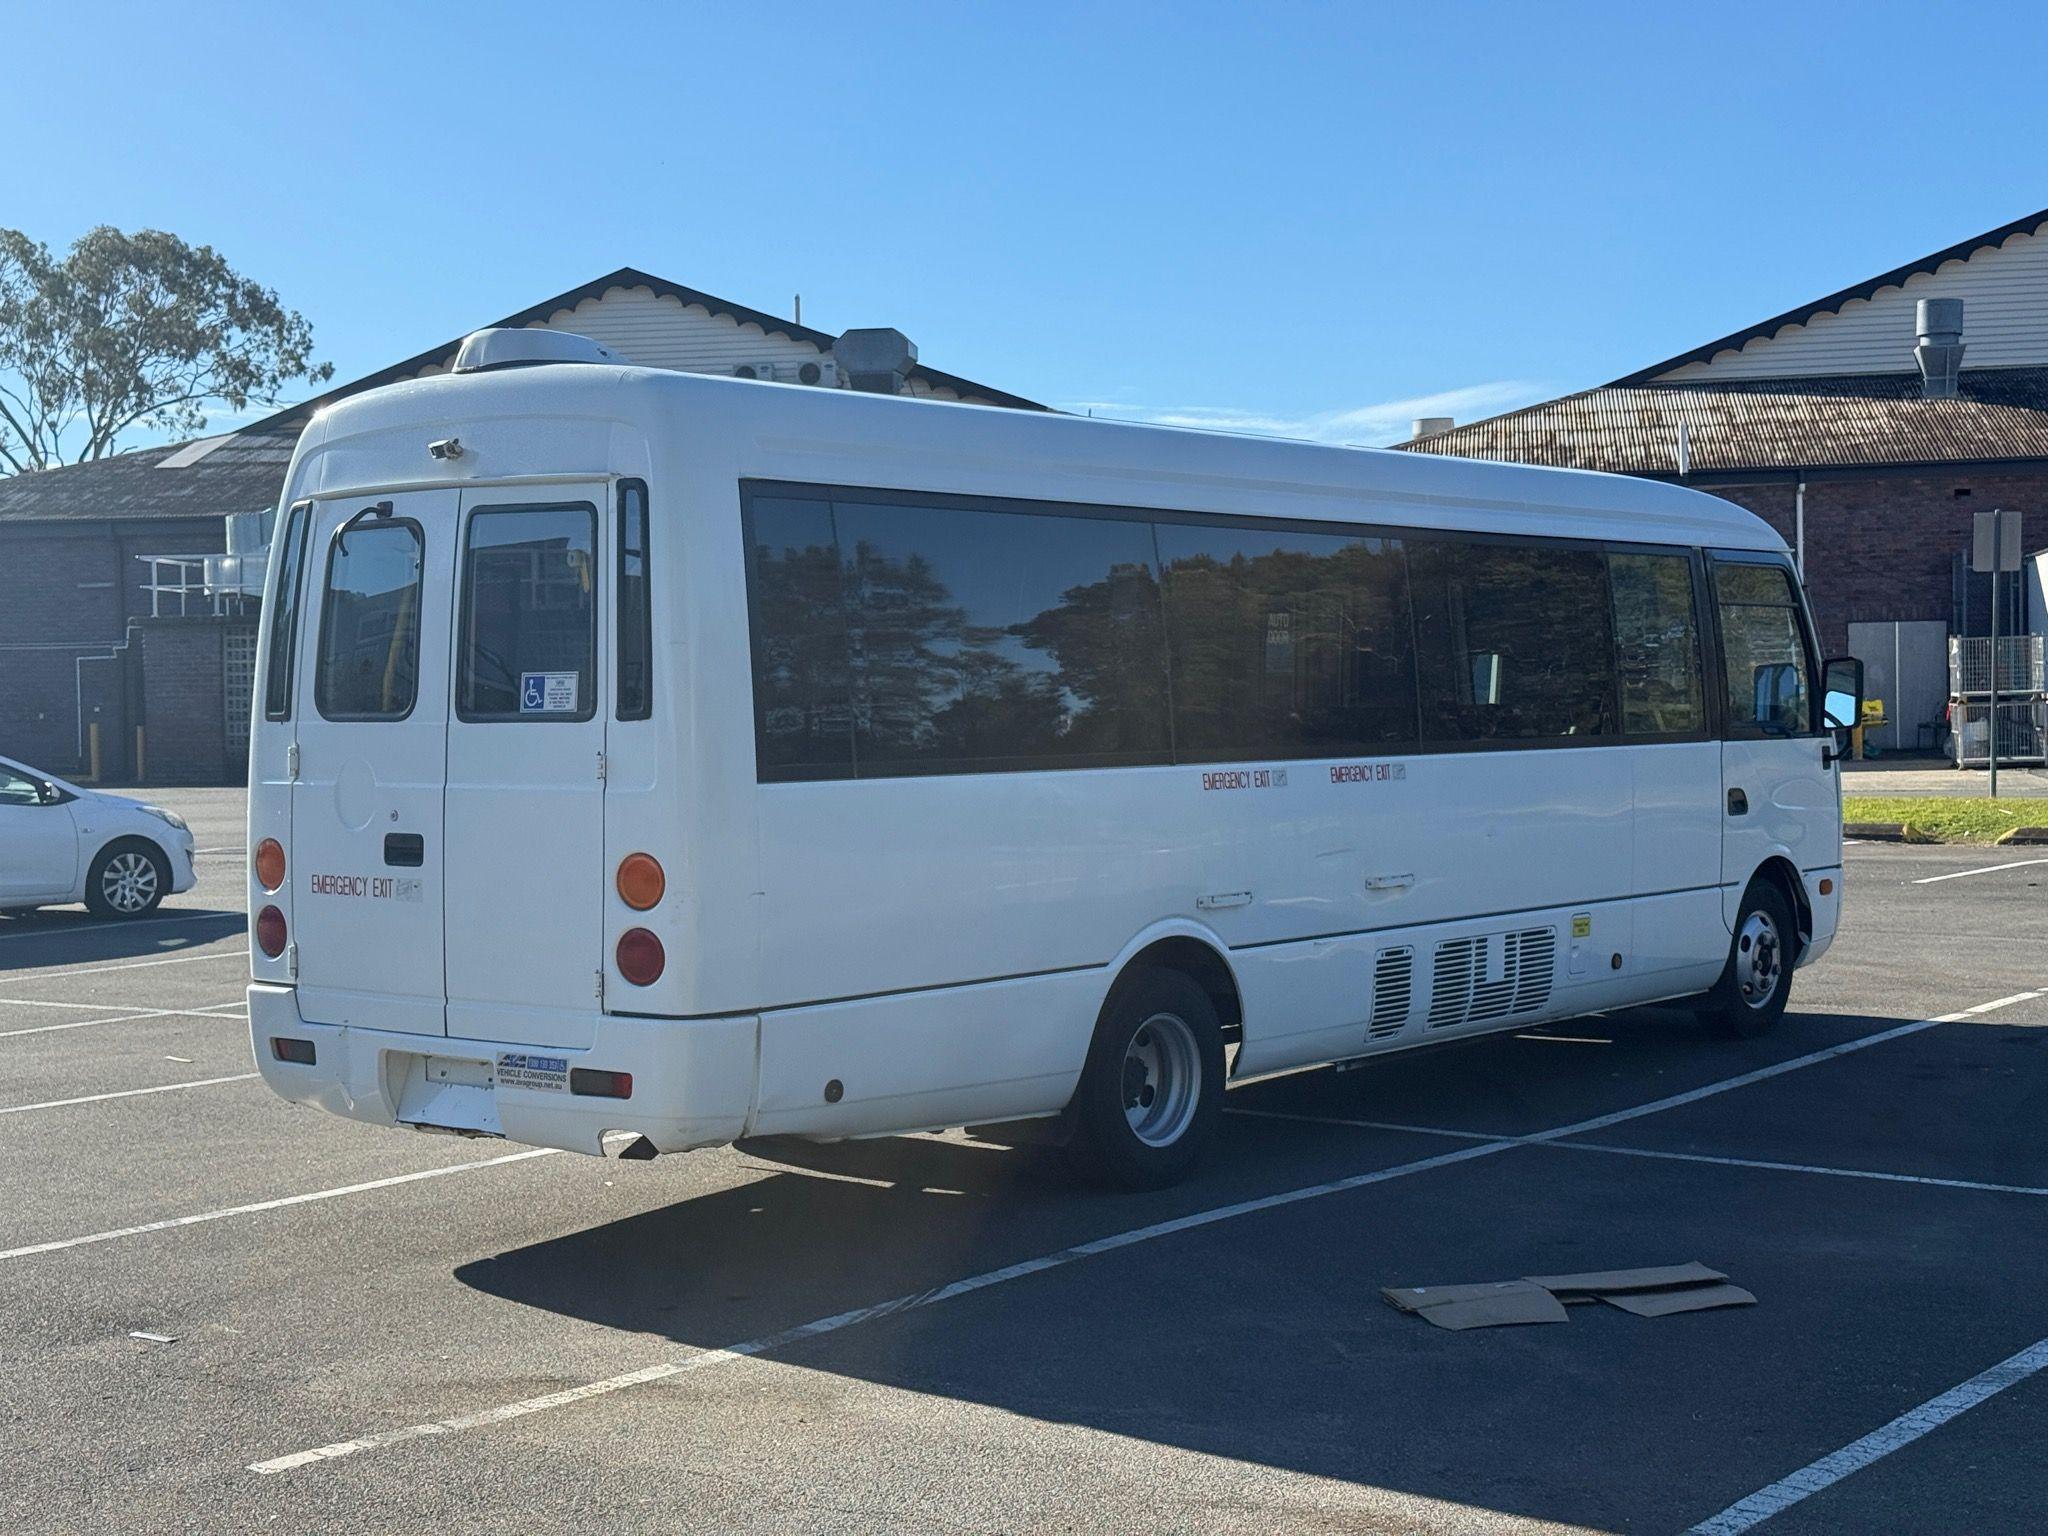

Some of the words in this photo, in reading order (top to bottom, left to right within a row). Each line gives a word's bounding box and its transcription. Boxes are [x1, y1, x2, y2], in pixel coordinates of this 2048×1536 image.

[1268, 613, 1289, 627] AUTO
[1267, 630, 1289, 644] DOOR
[1202, 771, 1250, 791] EMERGENCY
[1254, 770, 1270, 788] EXIT
[1330, 765, 1373, 783] EMERGENCY
[1376, 764, 1391, 781] EXIT
[311, 874, 369, 897] EMERGENCY
[373, 878, 394, 898] EXIT
[497, 1068, 522, 1077] VEHICLE
[523, 1070, 567, 1082] CONVERSIONS
